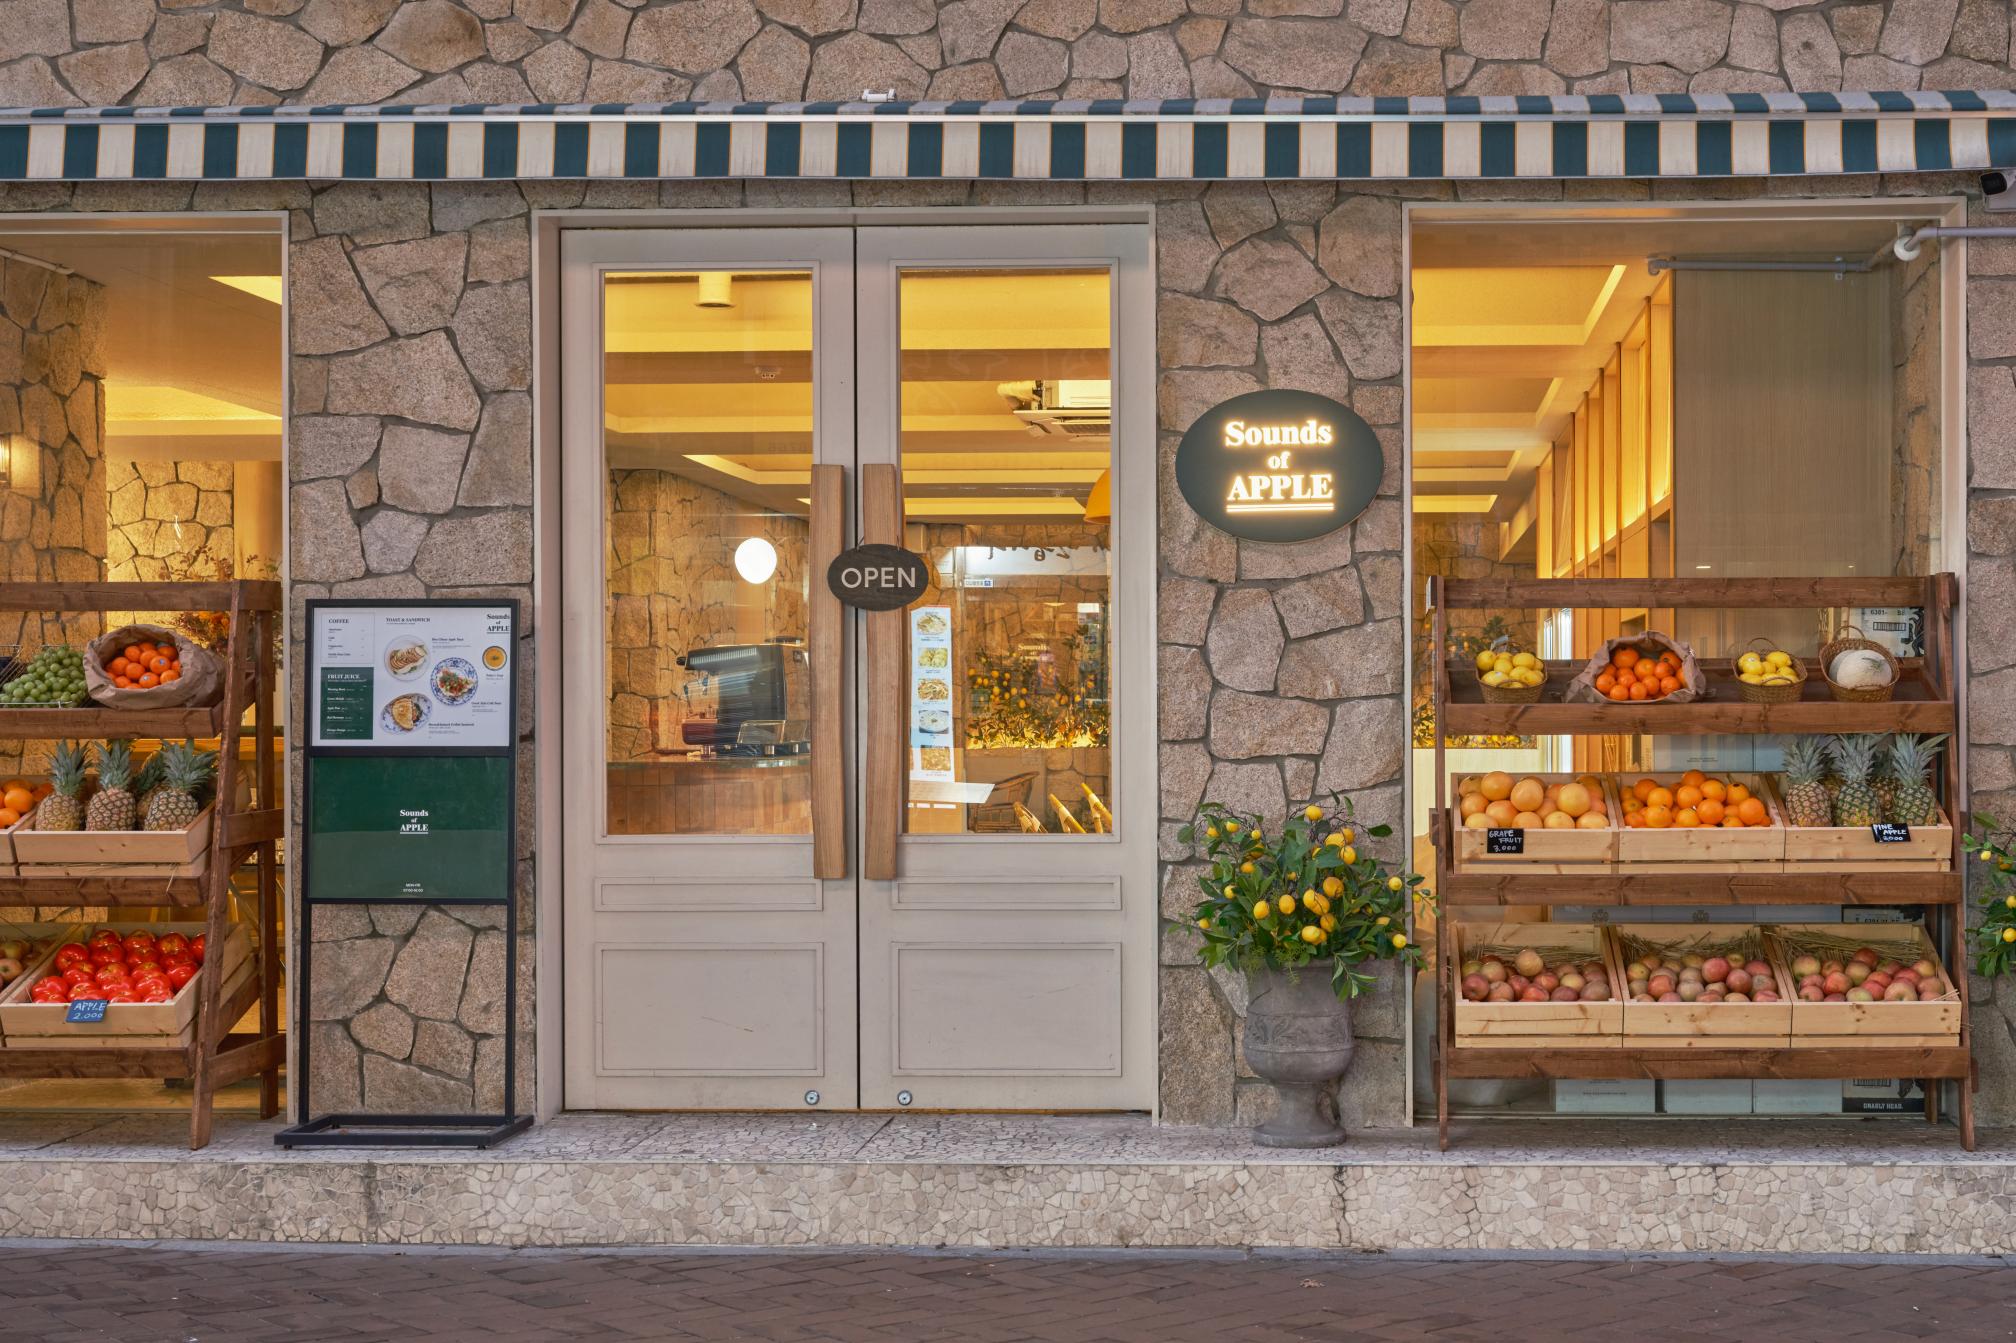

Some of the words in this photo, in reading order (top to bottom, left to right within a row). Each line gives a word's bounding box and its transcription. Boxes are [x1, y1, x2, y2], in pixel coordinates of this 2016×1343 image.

[1225, 420, 1332, 446] Sounds
[1268, 451, 1290, 469] of
[1227, 474, 1333, 500] APPLE
[841, 567, 916, 589] OPEN
[400, 809, 428, 817] Sounds
[400, 823, 428, 831] APPLE
[1873, 824, 1893, 834] PINE
[1489, 829, 1514, 838] GRAPE
[73, 1001, 107, 1011] APPLE
